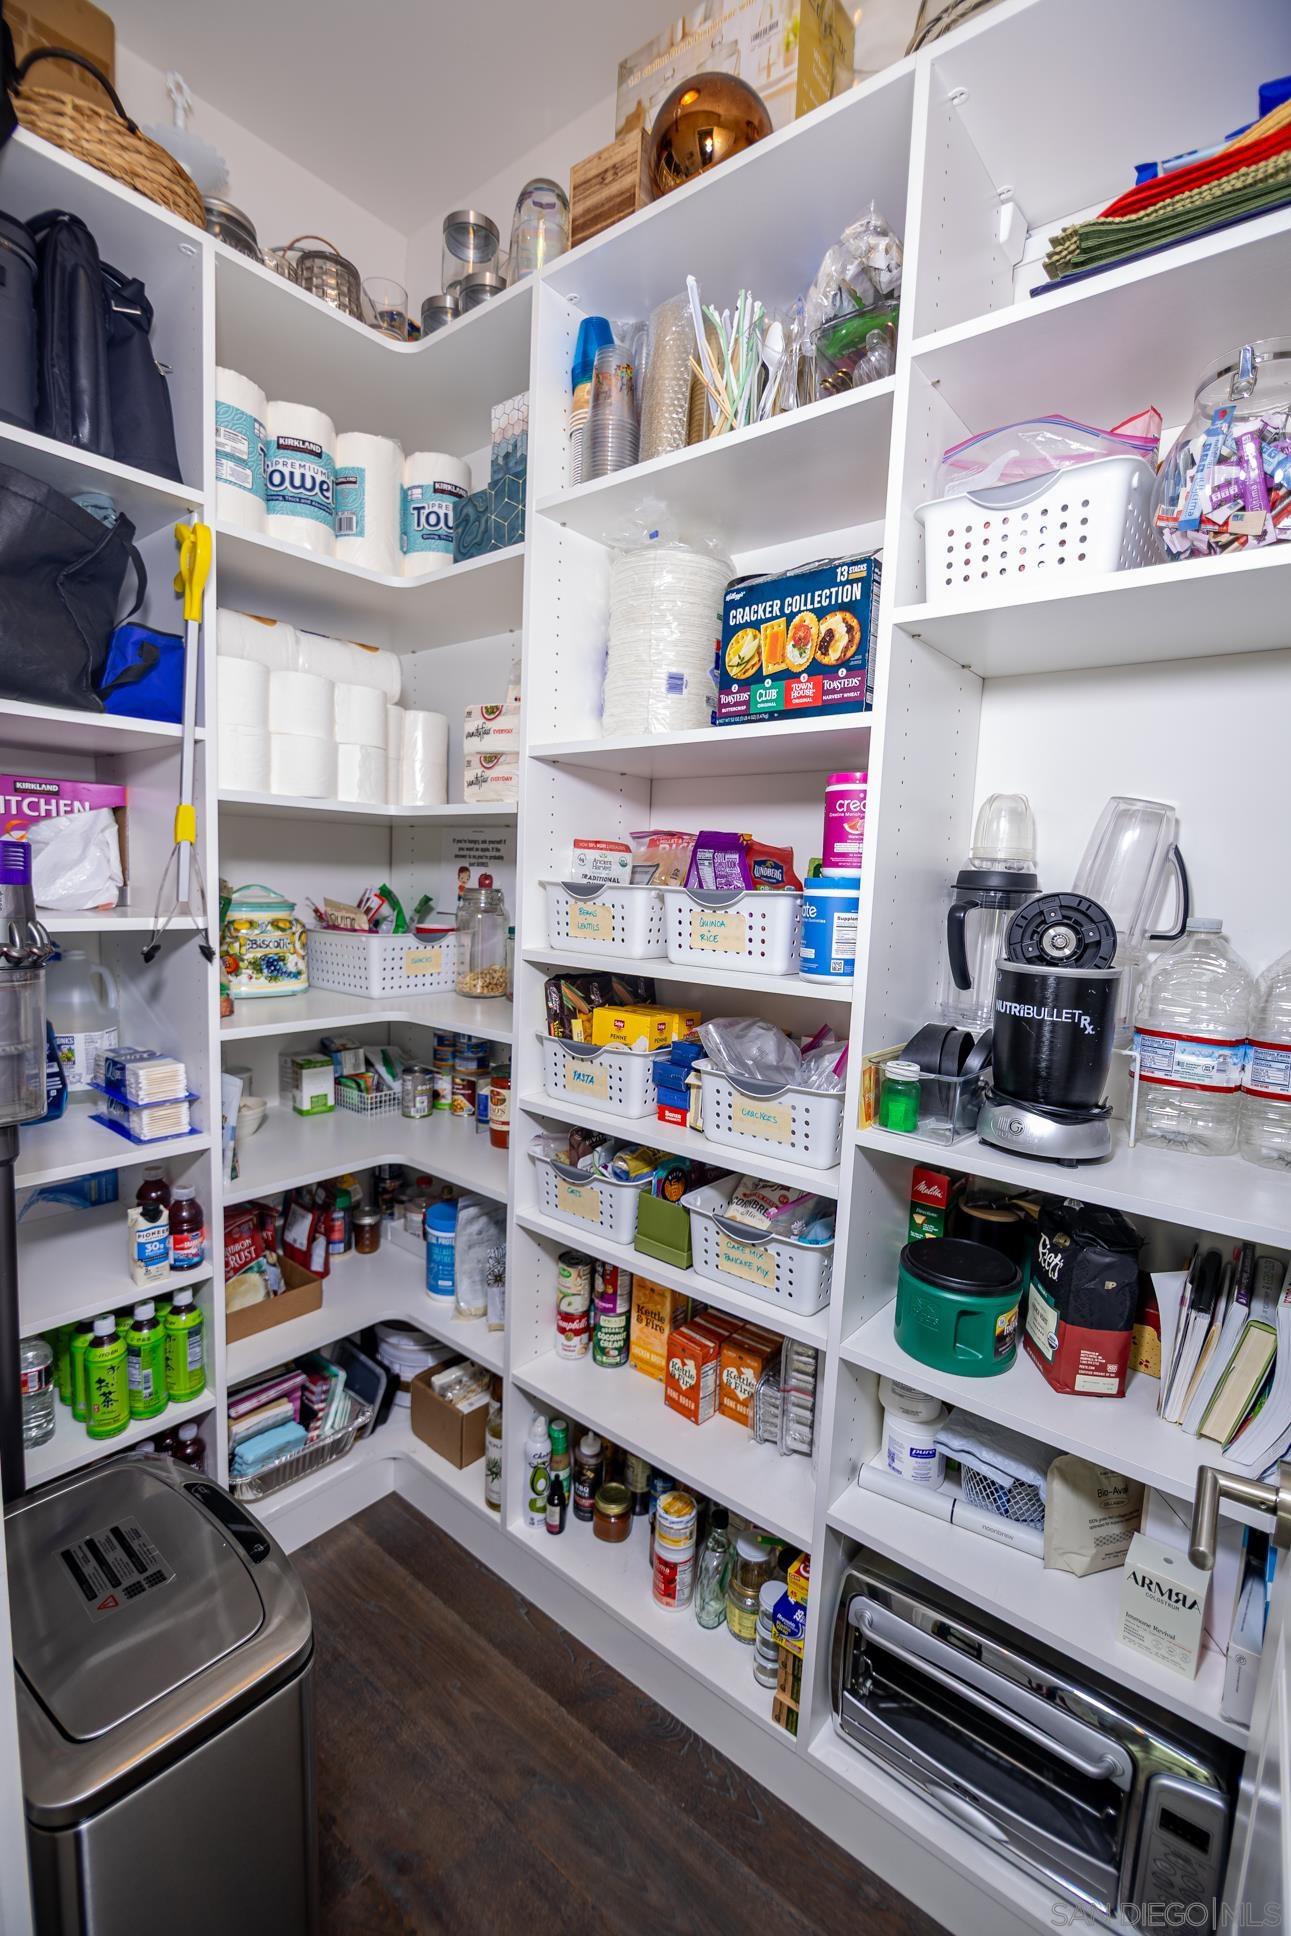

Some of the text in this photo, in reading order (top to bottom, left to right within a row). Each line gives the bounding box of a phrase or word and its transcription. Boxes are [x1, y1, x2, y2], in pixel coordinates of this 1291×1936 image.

[279, 437, 322, 454] KIRKLAND
[274, 459, 327, 478] PREMIUM
[267, 463, 336, 504] owe
[836, 563, 868, 583] 13 STACKS
[729, 583, 862, 626] CRACKER COLLECTION
[791, 682, 814, 692] TOWN
[823, 677, 861, 690] TOASTEDS
[720, 692, 750, 705] TOASTEDS
[756, 689, 778, 701] CLUB
[791, 689, 815, 698] HOUSE
[16, 781, 59, 793] KIRKLAND
[593, 857, 612, 866] Ancient
[581, 873, 621, 884] TRADITIONAL
[754, 865, 782, 881] LUNDBERG
[699, 933, 719, 944] RICE
[610, 1033, 628, 1041] PENNE
[573, 1070, 595, 1086] PASTA
[726, 1240, 745, 1252] CAKE
[724, 1254, 754, 1271] PANCAKE
[636, 1303, 666, 1325] Kettle
[644, 1319, 665, 1335] Fire
[597, 1331, 627, 1341] COCONUT
[599, 1340, 624, 1348] CREAM
[671, 1360, 695, 1382] Kettle
[726, 1369, 755, 1389] Kettle
[677, 1373, 693, 1389] Fire
[734, 1382, 753, 1397] Fire
[1145, 1591, 1180, 1612] COLOSTRUM
[1125, 1611, 1152, 1629] Immune
[1152, 1625, 1176, 1641] Revival
